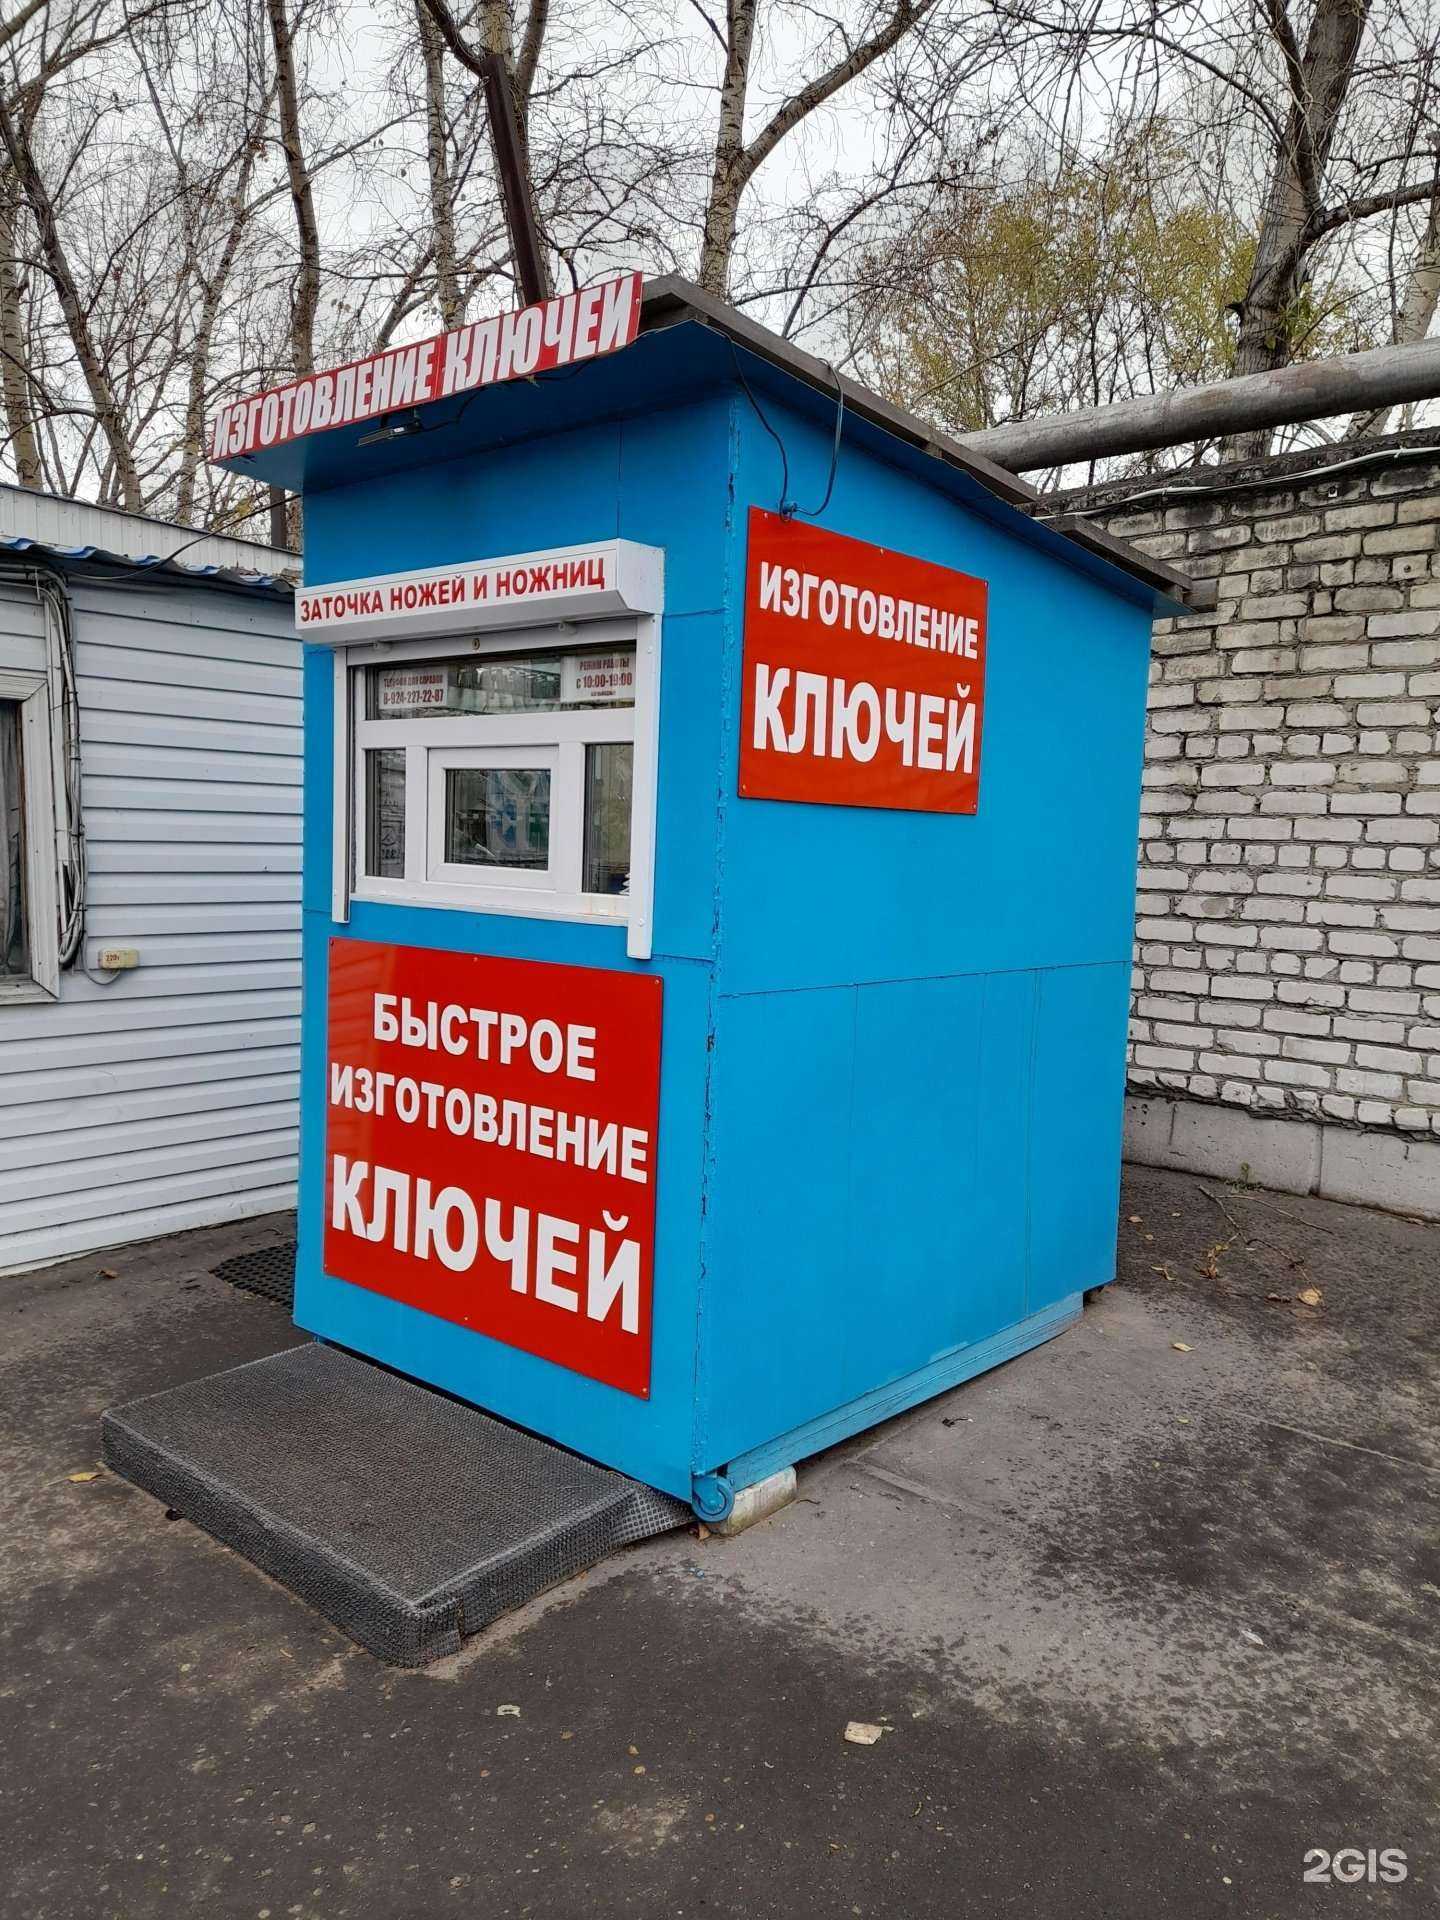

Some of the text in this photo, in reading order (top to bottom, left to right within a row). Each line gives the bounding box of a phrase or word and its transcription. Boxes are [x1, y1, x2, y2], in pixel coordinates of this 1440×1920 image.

[212, 341, 436, 460] ИЗГОТОВЛЕНИЕ
[300, 557, 606, 622] ЗАТОЧКА НОЖЕЙ И НОЖНИЦ
[759, 560, 979, 660] ИЗГОТОВЛЕНИЕ
[752, 663, 977, 775] КЛЮЧЕЙ
[373, 991, 597, 1082] БЫСТРОЕ
[330, 1062, 649, 1185] ИЗГОТОВЛЕНИЕ
[331, 1154, 642, 1335] КЛЮЧЕЙ
